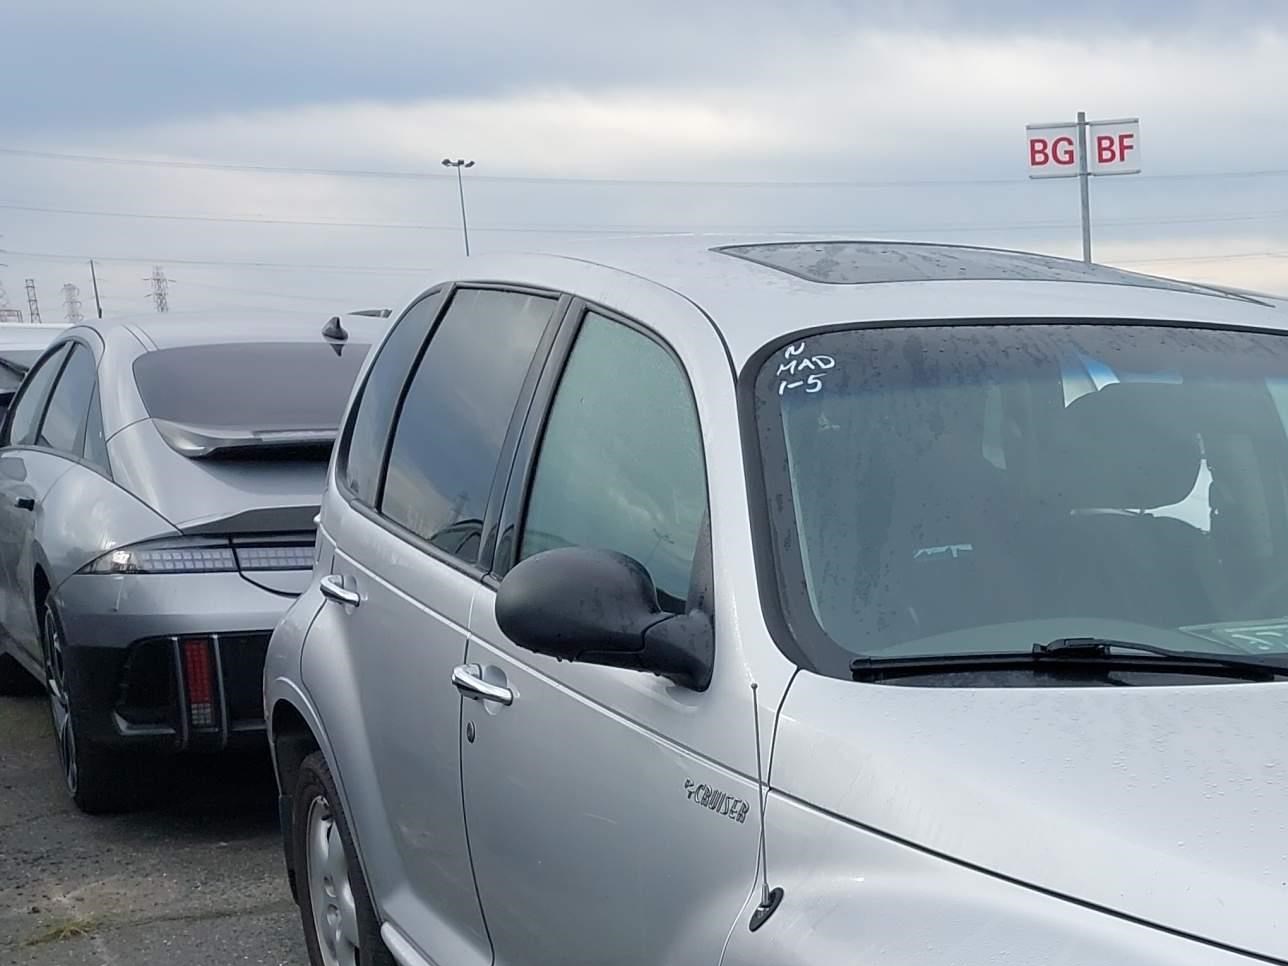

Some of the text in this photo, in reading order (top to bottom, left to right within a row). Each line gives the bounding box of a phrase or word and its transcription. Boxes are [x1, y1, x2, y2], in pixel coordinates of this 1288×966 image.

[1029, 137, 1075, 166] BG
[1097, 134, 1134, 163] BF
[776, 355, 835, 376] MAD
